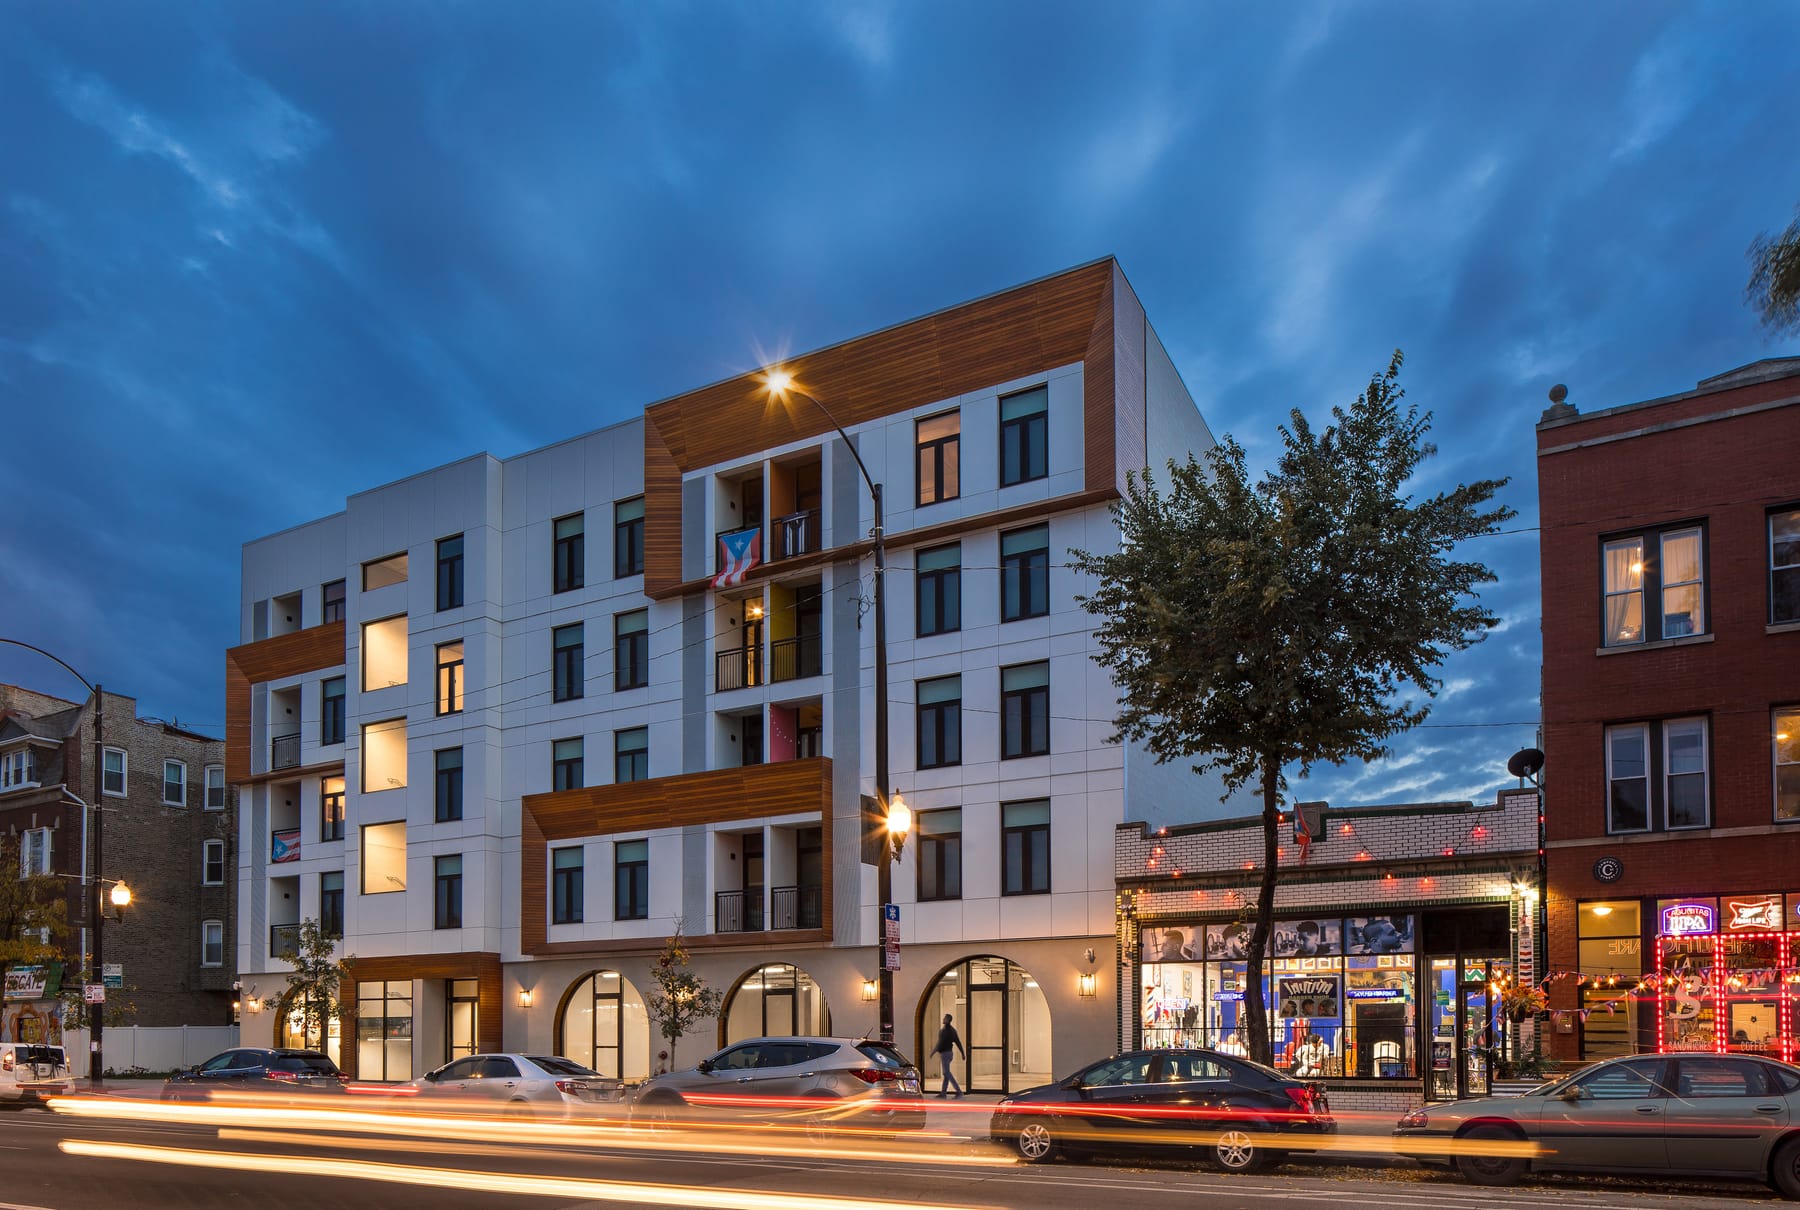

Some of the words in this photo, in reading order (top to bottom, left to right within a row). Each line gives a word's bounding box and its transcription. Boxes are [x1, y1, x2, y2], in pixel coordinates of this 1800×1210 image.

[1670, 915, 1707, 930] IPA
[1668, 1040, 1712, 1051] SANDWICHES
[1740, 1040, 1768, 1051] COFFEE
